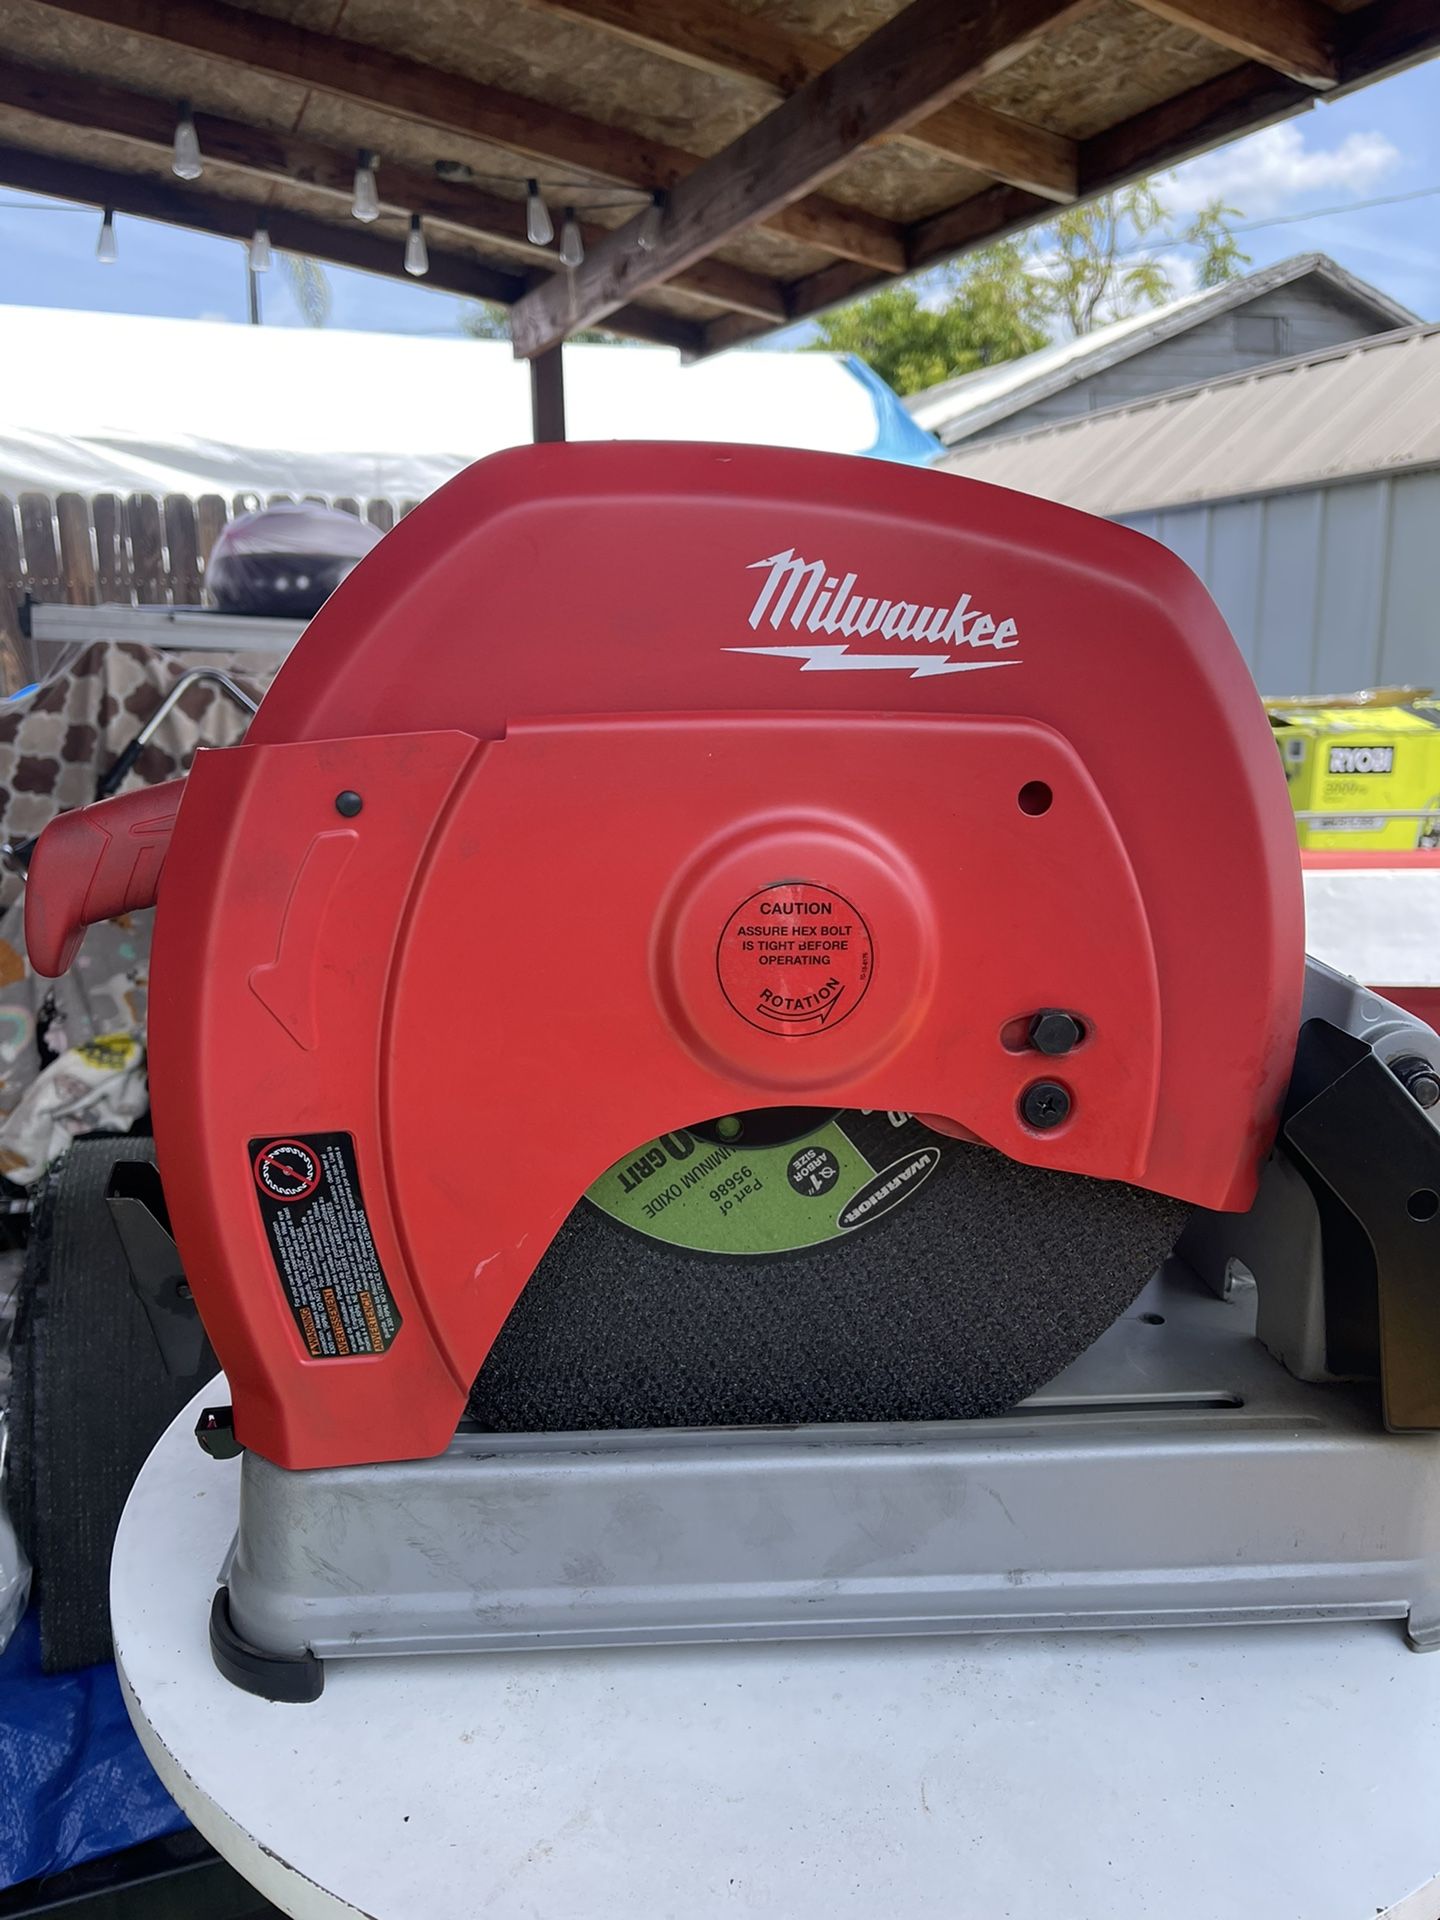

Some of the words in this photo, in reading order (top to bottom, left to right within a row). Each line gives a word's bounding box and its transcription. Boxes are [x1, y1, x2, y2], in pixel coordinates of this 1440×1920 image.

[745, 548, 1020, 650] Milwaukee
[1329, 746, 1394, 773] RYOBI
[760, 902, 832, 915] CAUTION
[737, 926, 788, 936] ASSURE
[792, 926, 817, 936] HEX
[821, 925, 852, 936] BOLT
[742, 941, 754, 950] IS
[758, 941, 795, 950] TIGHT
[799, 940, 849, 950] BEFORE
[759, 955, 831, 965] OPERATING
[759, 977, 840, 1011] ROTATION
[887, 1111, 913, 1128] D
[616, 1147, 668, 1194] GRIT
[792, 1149, 817, 1171] SIZE
[793, 1152, 828, 1182] ARBOR
[709, 1165, 753, 1202] 95686
[733, 1178, 764, 1204] Part
[847, 1154, 932, 1223] WARRIOR
[640, 1183, 683, 1219] OXIDE
[719, 1200, 734, 1217] of
[310, 1277, 318, 1289] USE
[301, 1308, 319, 1347] WARNING
[324, 1290, 347, 1353] AVERTISSEMENT
[361, 1293, 383, 1350] ADVERTENCIA
